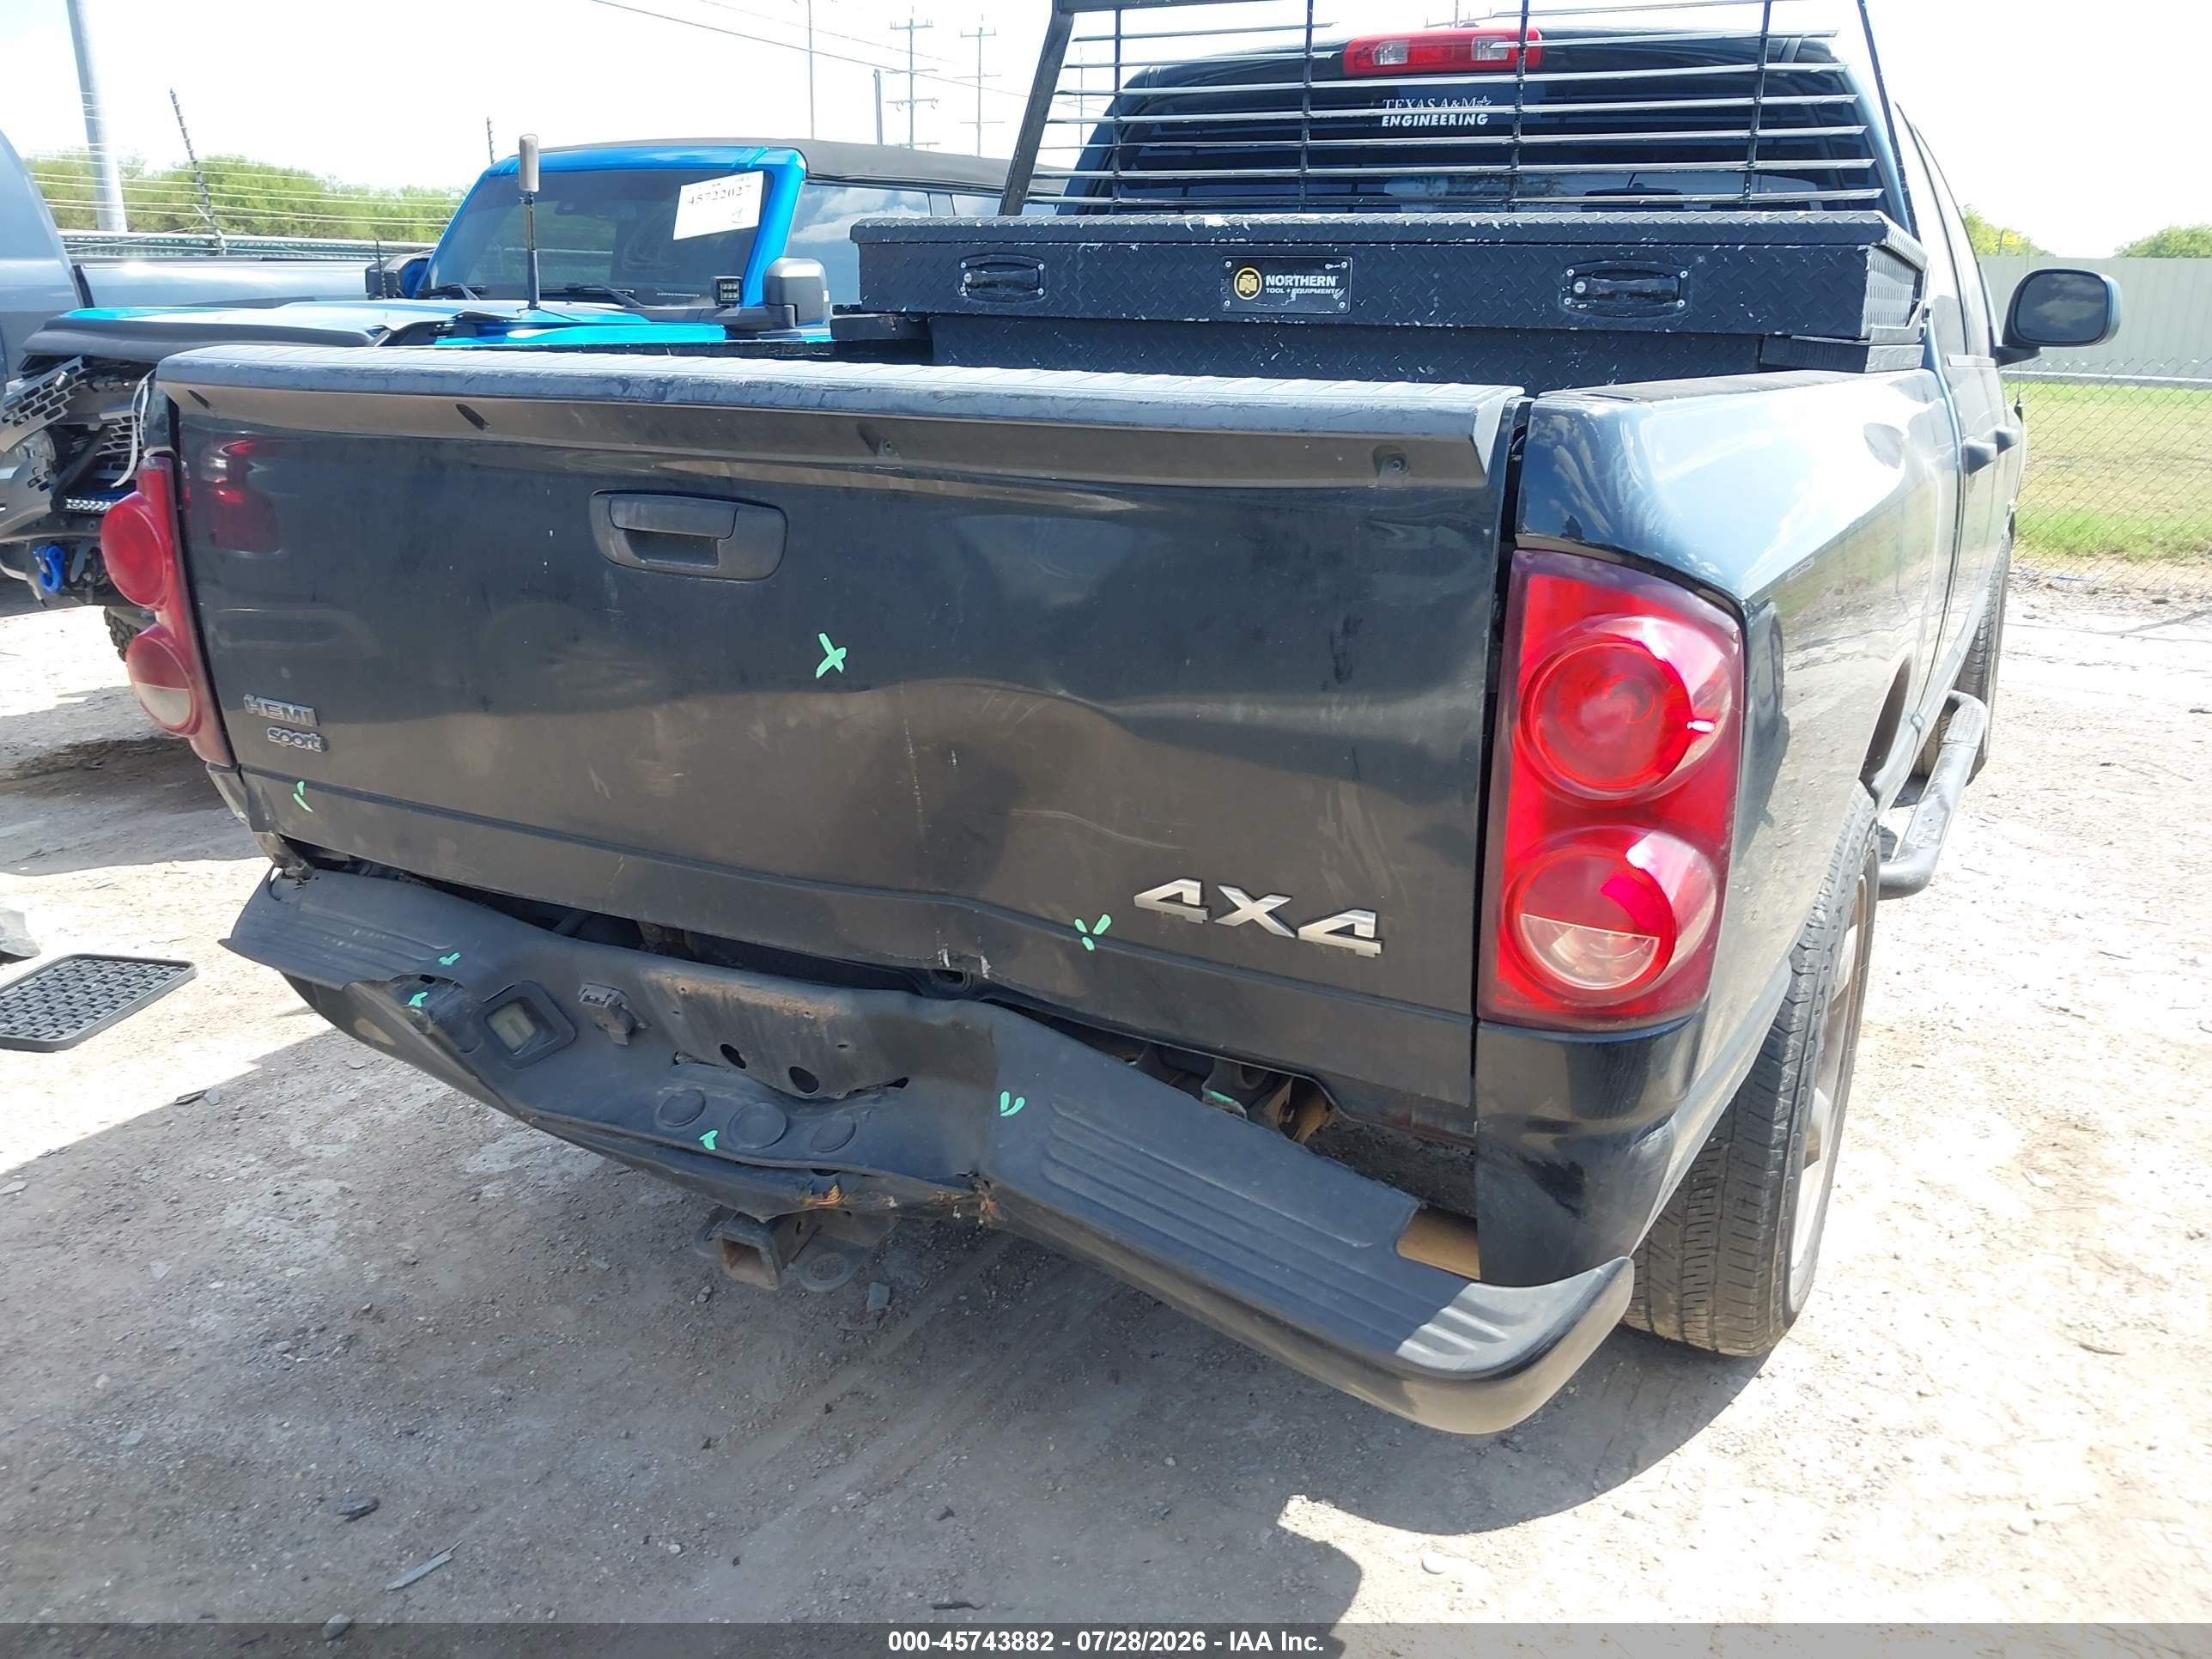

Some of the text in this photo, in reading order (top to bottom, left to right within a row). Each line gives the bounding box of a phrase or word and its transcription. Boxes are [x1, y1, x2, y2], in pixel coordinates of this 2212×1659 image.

[1382, 98, 1435, 109] TEXAS
[1382, 114, 1488, 126] ENGINEERING
[1265, 274, 1337, 287] NORTHERN
[243, 694, 317, 726] HEMI
